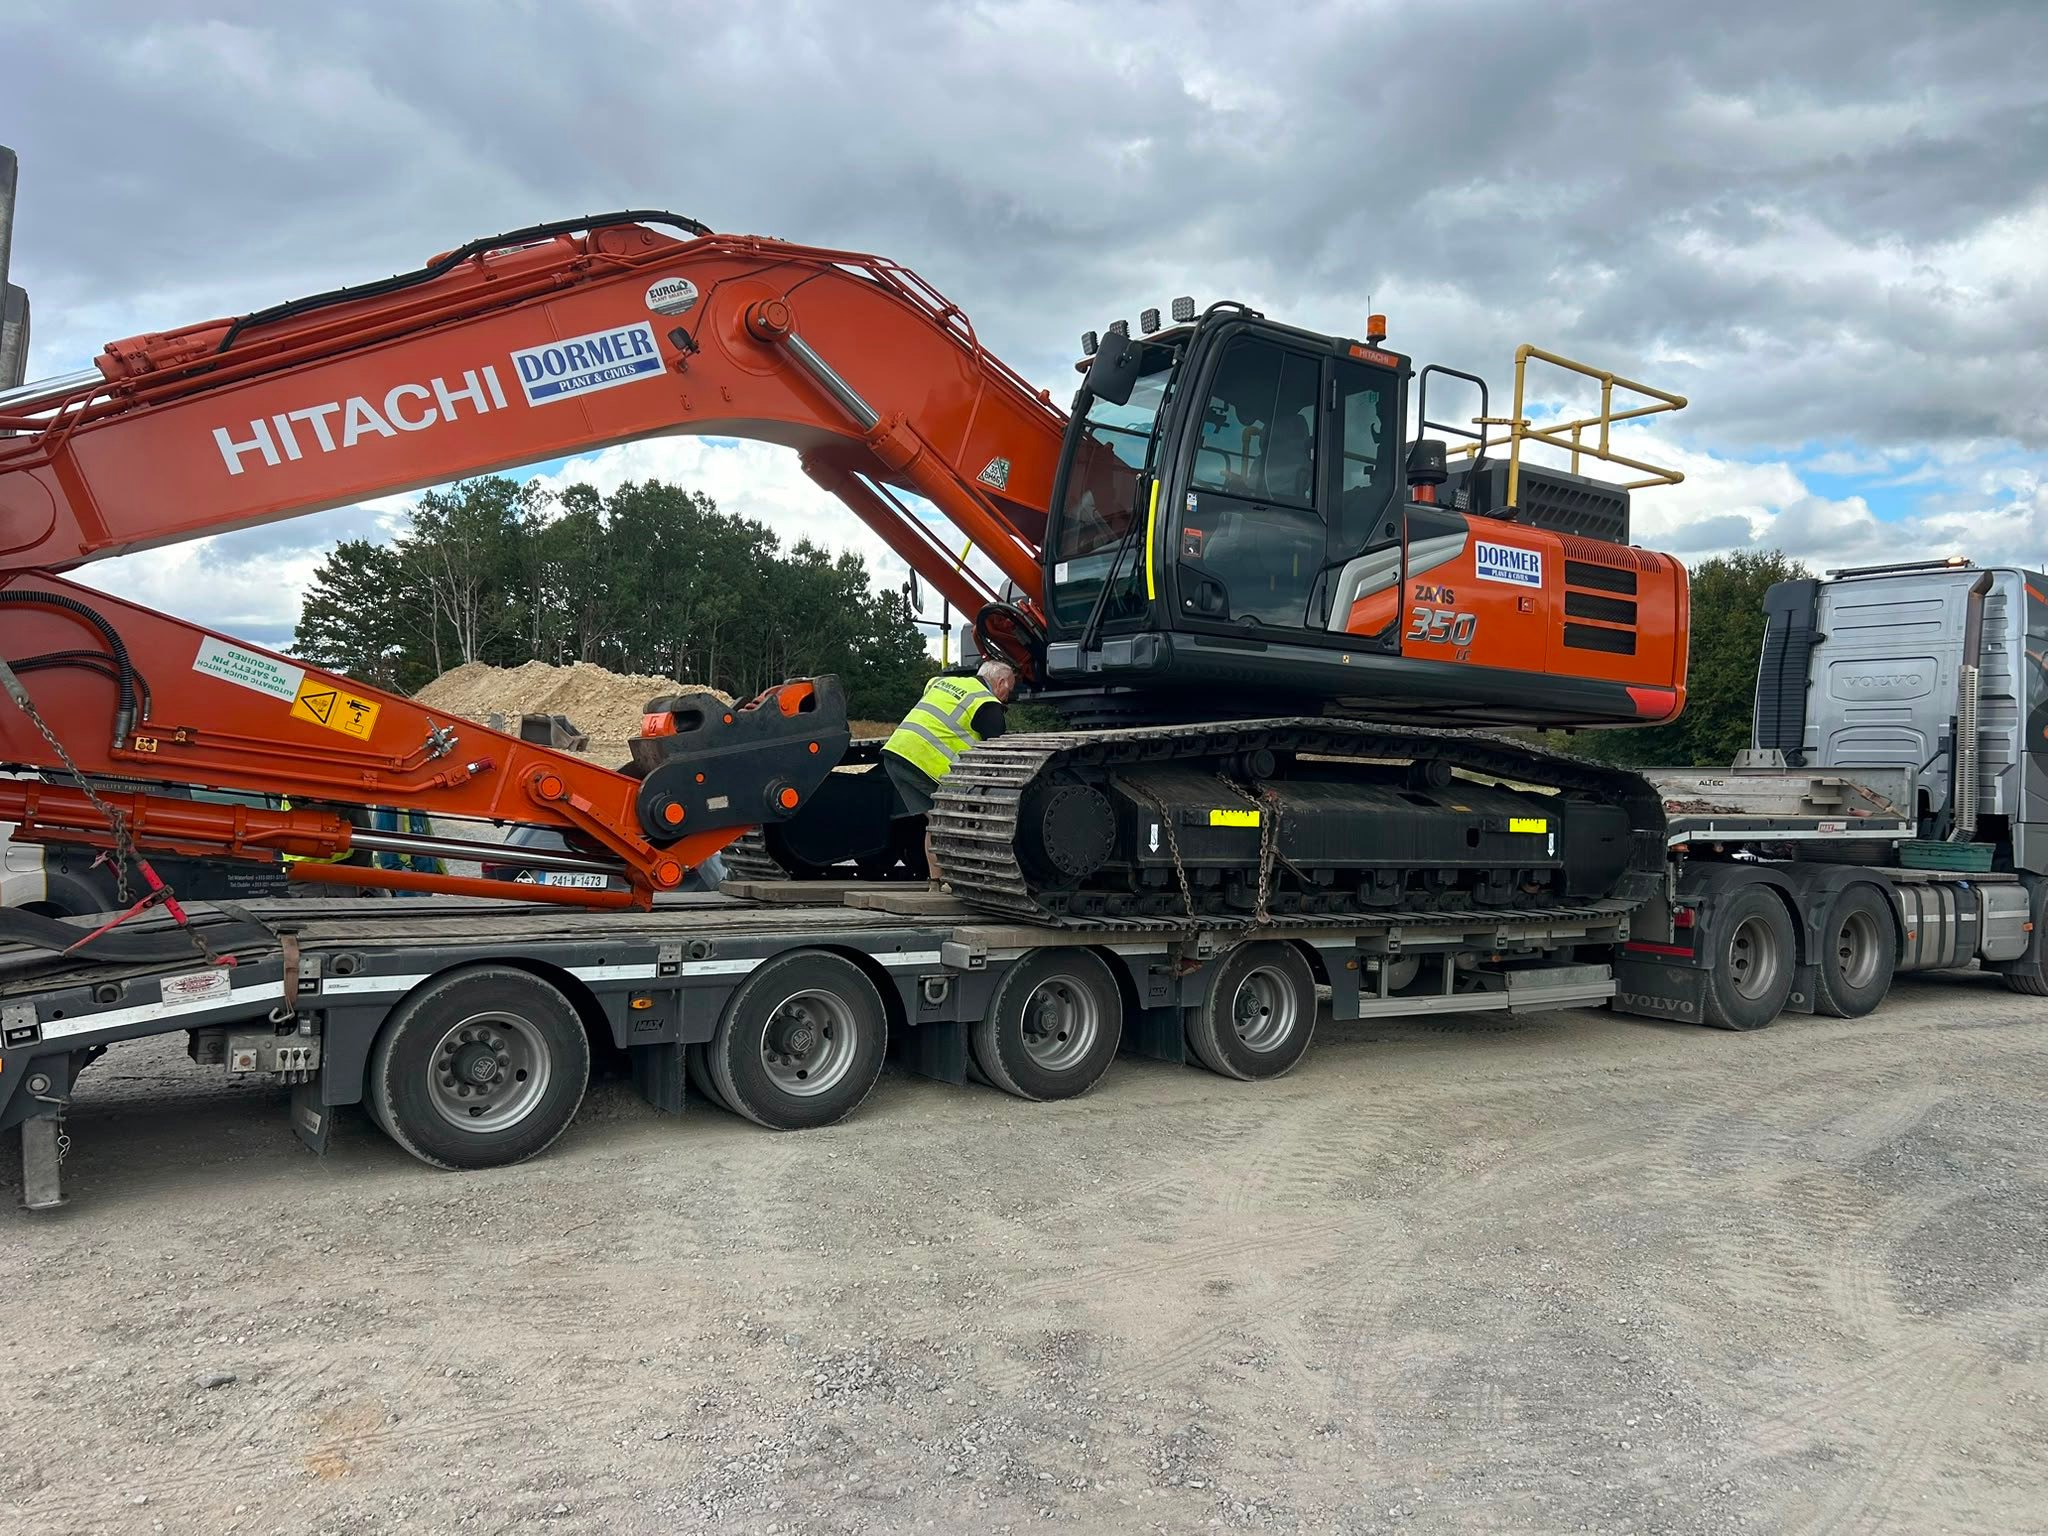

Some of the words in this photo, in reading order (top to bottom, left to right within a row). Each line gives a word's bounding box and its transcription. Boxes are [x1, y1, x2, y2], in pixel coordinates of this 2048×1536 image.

[648, 284, 677, 299] EURO
[517, 329, 654, 383] DORMER
[1360, 348, 1389, 363] HITACHI
[559, 375, 592, 391] PLANT
[594, 373, 602, 382] &
[605, 365, 636, 380] CIVILS
[212, 366, 508, 475] HITACHI
[1478, 545, 1538, 572] DORMER
[1491, 569, 1507, 577] PLANT
[1513, 572, 1529, 581] CIVILS
[1415, 584, 1455, 605] ZAXIS
[1405, 606, 1477, 646] 350
[197, 659, 221, 672] HITCH
[212, 655, 229, 667] PIN
[227, 651, 277, 672] REQUIRED
[223, 667, 249, 681] QUICK
[231, 662, 270, 680] SAFETY
[250, 677, 294, 696] AUTOMATIC
[271, 675, 286, 685] NO
[1841, 674, 1922, 688] VOLVO
[93, 782, 121, 790] QUALITY
[1699, 779, 1724, 787] ALTEC
[552, 875, 601, 887] 241-W-1473
[1622, 992, 1694, 1014] VOLVO
